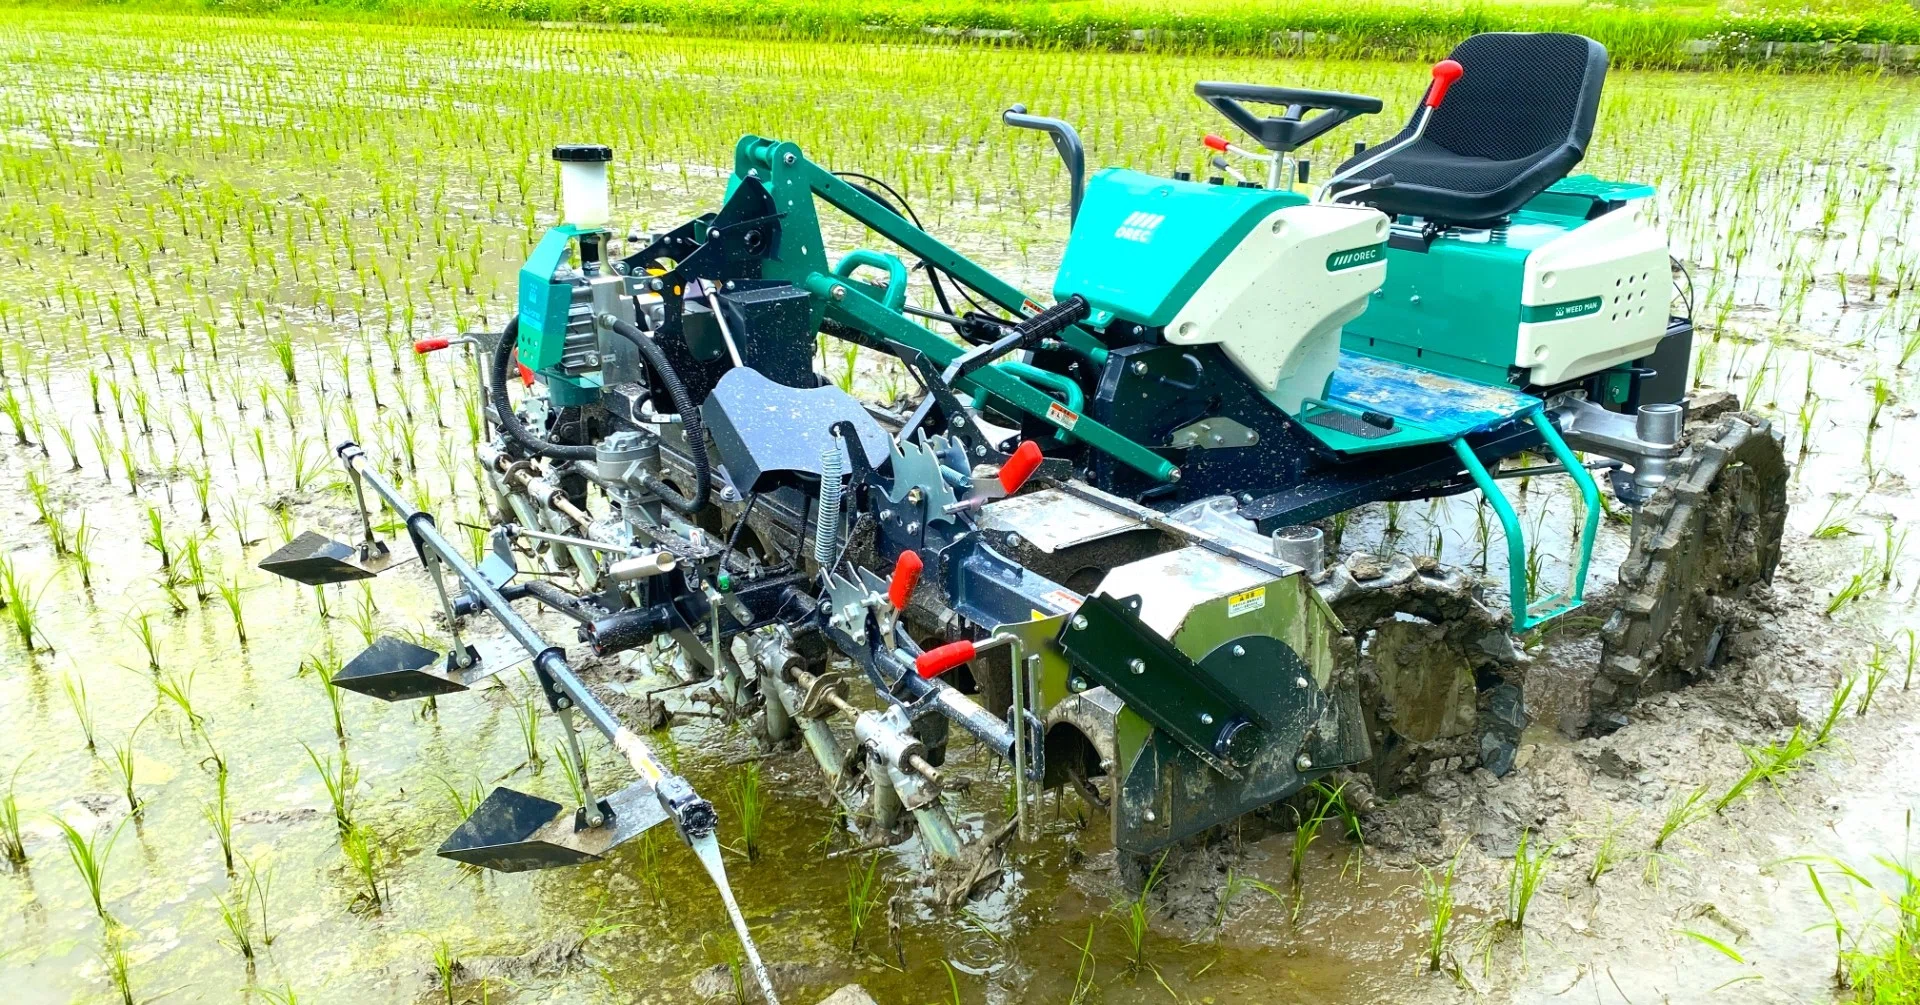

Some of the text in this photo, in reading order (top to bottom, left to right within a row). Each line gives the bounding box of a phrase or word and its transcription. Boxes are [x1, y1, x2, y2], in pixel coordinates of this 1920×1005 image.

[1115, 227, 1151, 243] OREC
[1353, 249, 1376, 261] OREC
[1565, 302, 1598, 313] WEED MAN
